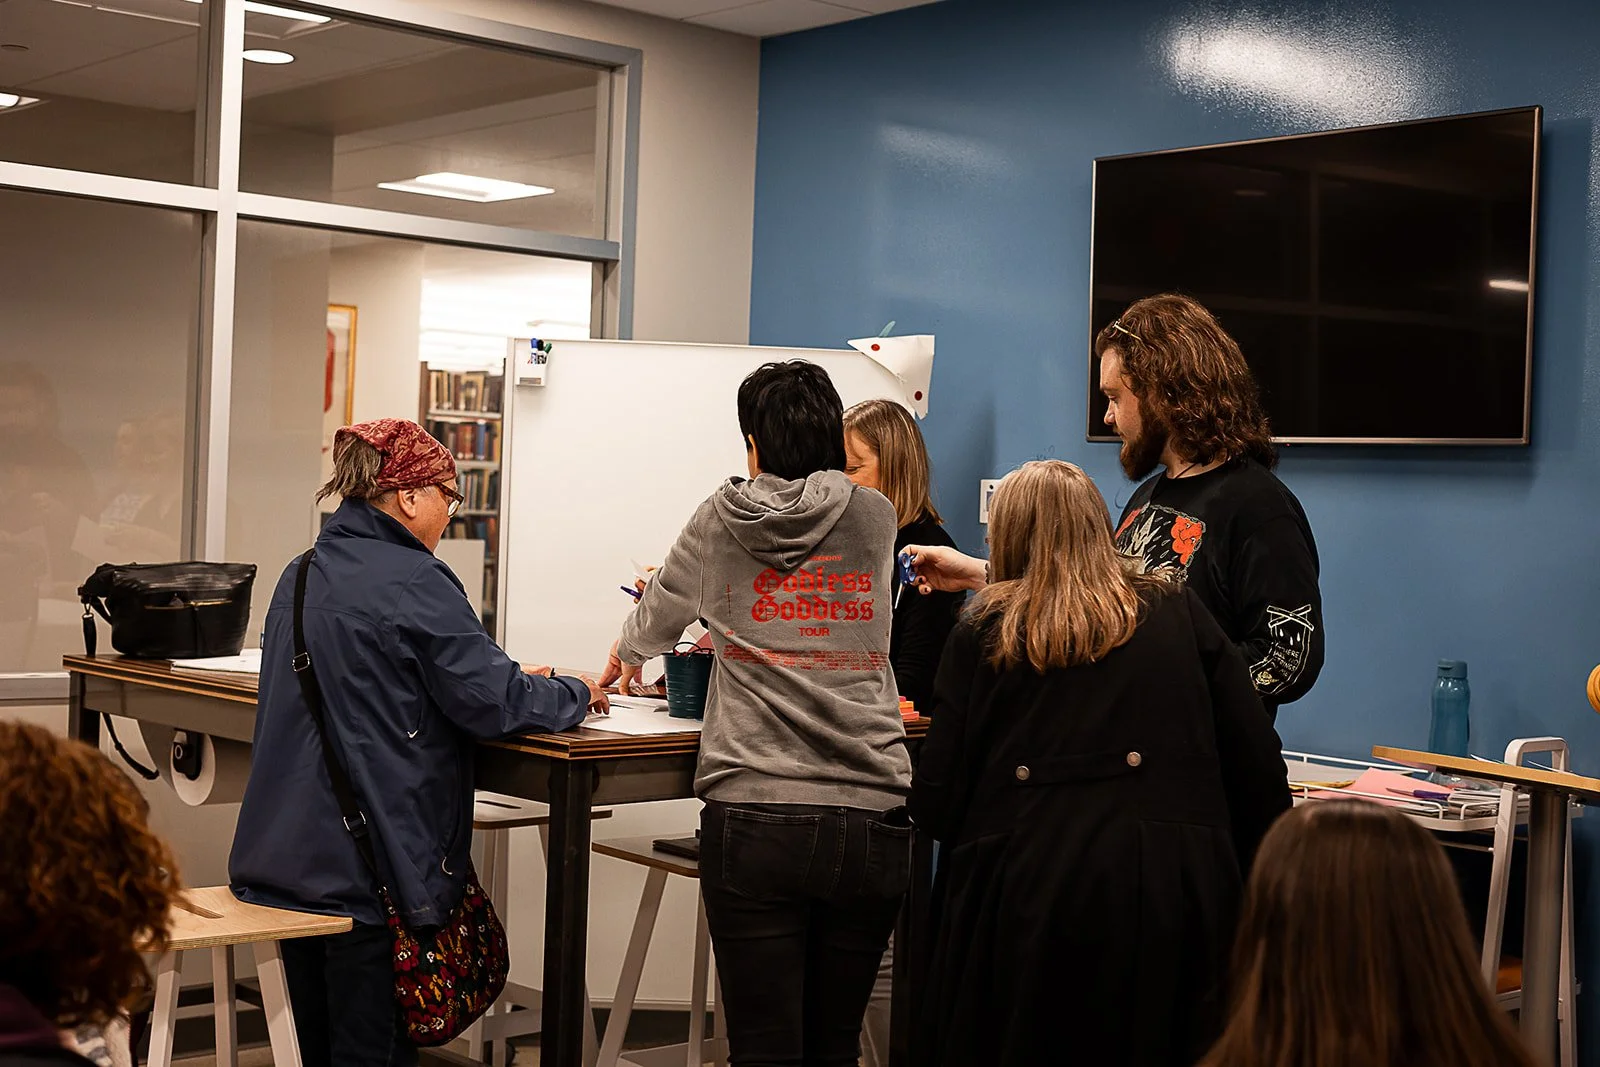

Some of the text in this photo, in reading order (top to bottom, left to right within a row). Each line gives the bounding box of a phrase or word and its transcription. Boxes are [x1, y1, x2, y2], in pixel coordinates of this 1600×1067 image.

[753, 567, 874, 594] Godless
[751, 594, 875, 622] Goddess
[798, 627, 830, 637] TOUR
